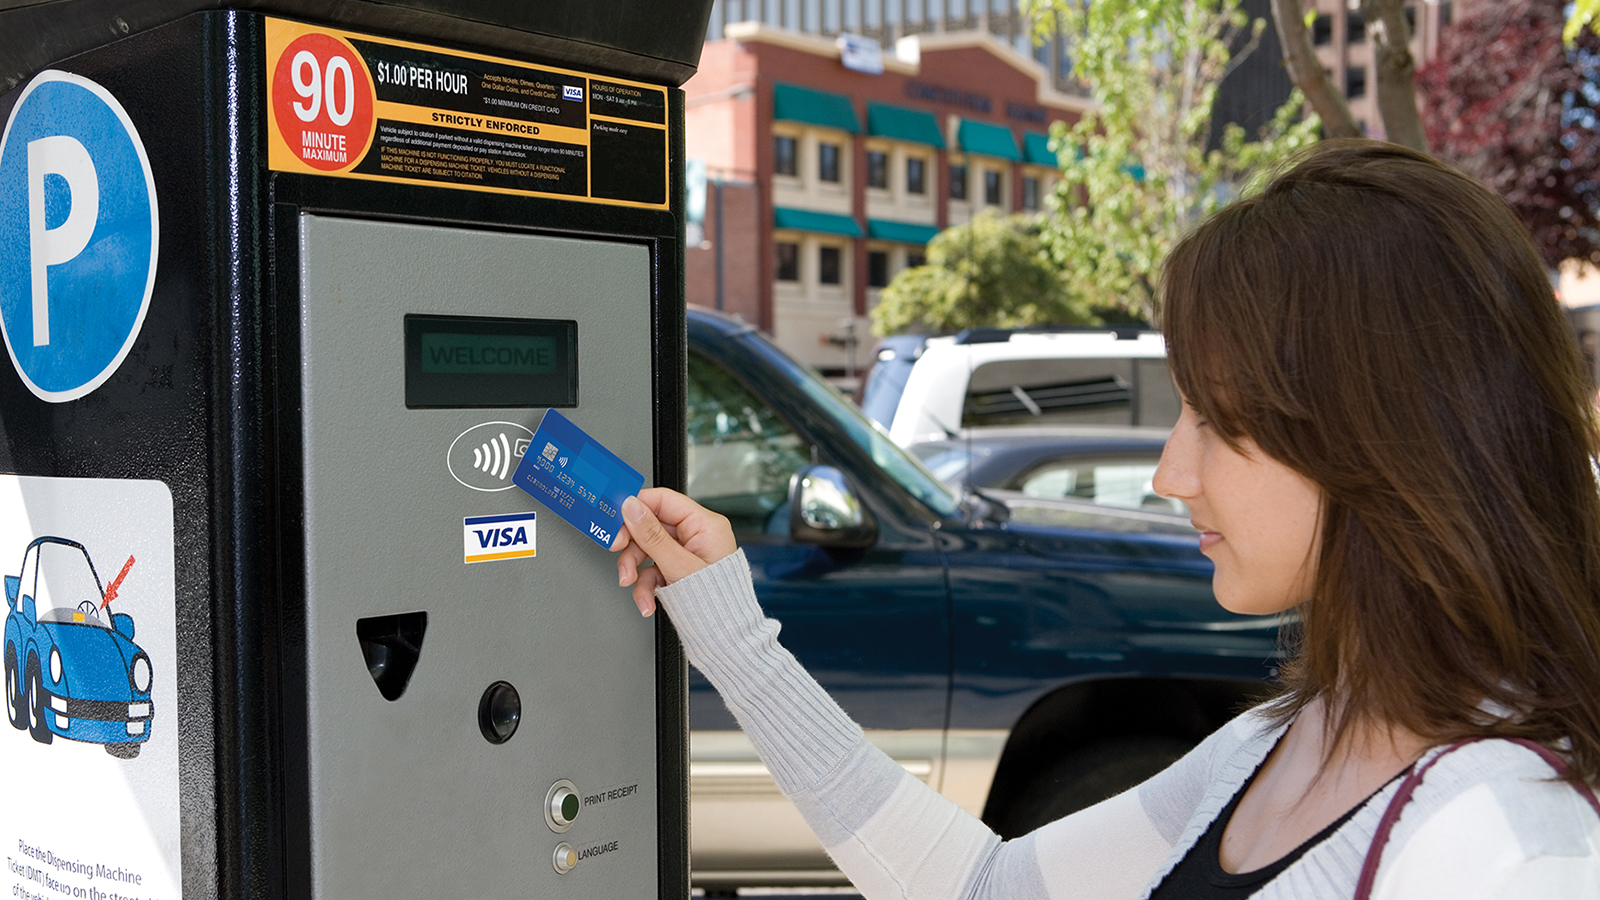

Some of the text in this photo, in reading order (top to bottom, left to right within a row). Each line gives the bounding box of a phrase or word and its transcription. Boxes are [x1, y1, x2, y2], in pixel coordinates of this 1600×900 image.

[291, 50, 354, 126] 90
[377, 60, 468, 95] $1.00 PER HOUR
[484, 74, 501, 82] Accepts
[492, 83, 505, 91] Dollar
[530, 89, 542, 97] Credit
[565, 87, 582, 96] VISA
[592, 84, 608, 92] HOURS
[616, 87, 642, 97] OPERATION
[498, 98, 520, 108] MINIMUM
[520, 102, 528, 110] ON
[528, 103, 546, 112] CREDIT
[546, 106, 560, 114] CARD
[432, 112, 540, 135] STRICTLY ENFORCED
[302, 130, 346, 151] MINUTE
[380, 126, 396, 134] Vehicle
[483, 138, 504, 148] dispensing
[505, 141, 521, 150] machine
[538, 146, 550, 154] longer
[380, 135, 404, 144] regardless
[411, 138, 432, 147] additional
[432, 141, 452, 150] payment
[452, 143, 473, 152] deposited
[488, 147, 501, 155] station
[302, 148, 347, 163] MAXIMUM
[398, 148, 420, 157] MACHINE
[437, 152, 468, 162] FUNCTIONING
[518, 162, 535, 170] LOCATE
[540, 164, 566, 173] FUNCTIONAL
[381, 154, 403, 164] MACHINE
[419, 159, 448, 168] DISPENSING
[448, 162, 469, 171] MACHINE
[488, 167, 509, 175] VEHICLES
[510, 169, 530, 177] WITHOUT
[534, 172, 560, 180] DISPENSING
[381, 163, 403, 172] MACHINE
[404, 165, 421, 173] TICKET
[433, 168, 453, 177] SUBJECT
[27, 135, 99, 347] P
[430, 347, 550, 366] WELCOME
[526, 474, 558, 499] CARDHOLDER
[537, 456, 554, 473] 4000
[556, 472, 576, 488] 1234
[577, 486, 596, 504] 5678
[598, 500, 616, 518] 9010
[473, 526, 528, 548] VISA
[590, 520, 611, 544] VISA
[584, 784, 638, 806] PRINT RECEIPT
[578, 840, 618, 860] LANGUAGE
[18, 839, 142, 886] Place the Dispensing Machine
[7, 856, 25, 878] Ticket
[26, 866, 45, 887] (DMT)
[46, 873, 59, 891] face
[73, 887, 86, 899] on
[89, 886, 106, 900] the
